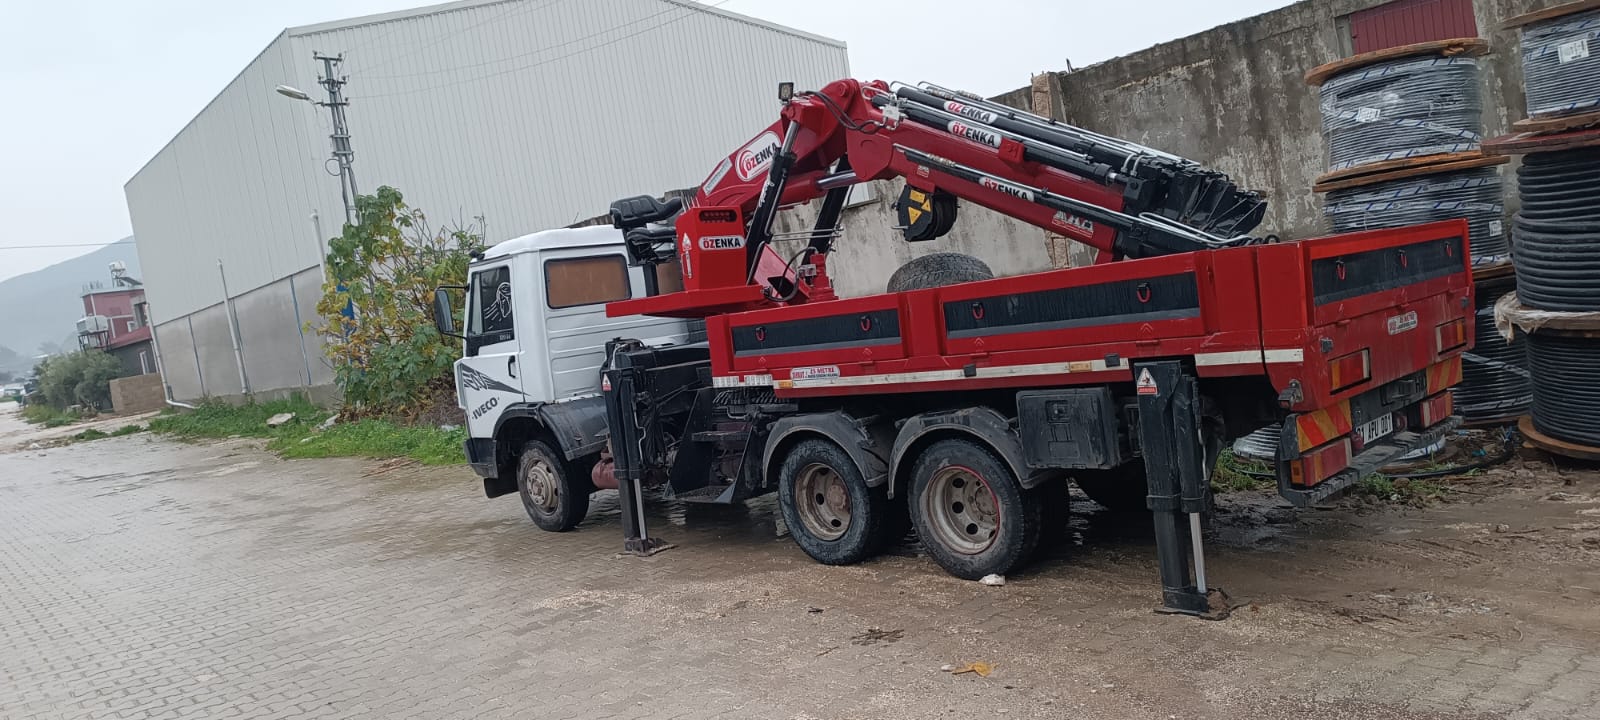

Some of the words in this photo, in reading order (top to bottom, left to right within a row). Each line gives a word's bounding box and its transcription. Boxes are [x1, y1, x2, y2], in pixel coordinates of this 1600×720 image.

[952, 121, 996, 147] ÖZENKA
[744, 142, 779, 172] ÖZENKA
[984, 178, 1029, 201] ÖZENKA
[703, 237, 742, 249] ÖZENKA
[473, 397, 499, 420] IVECO
